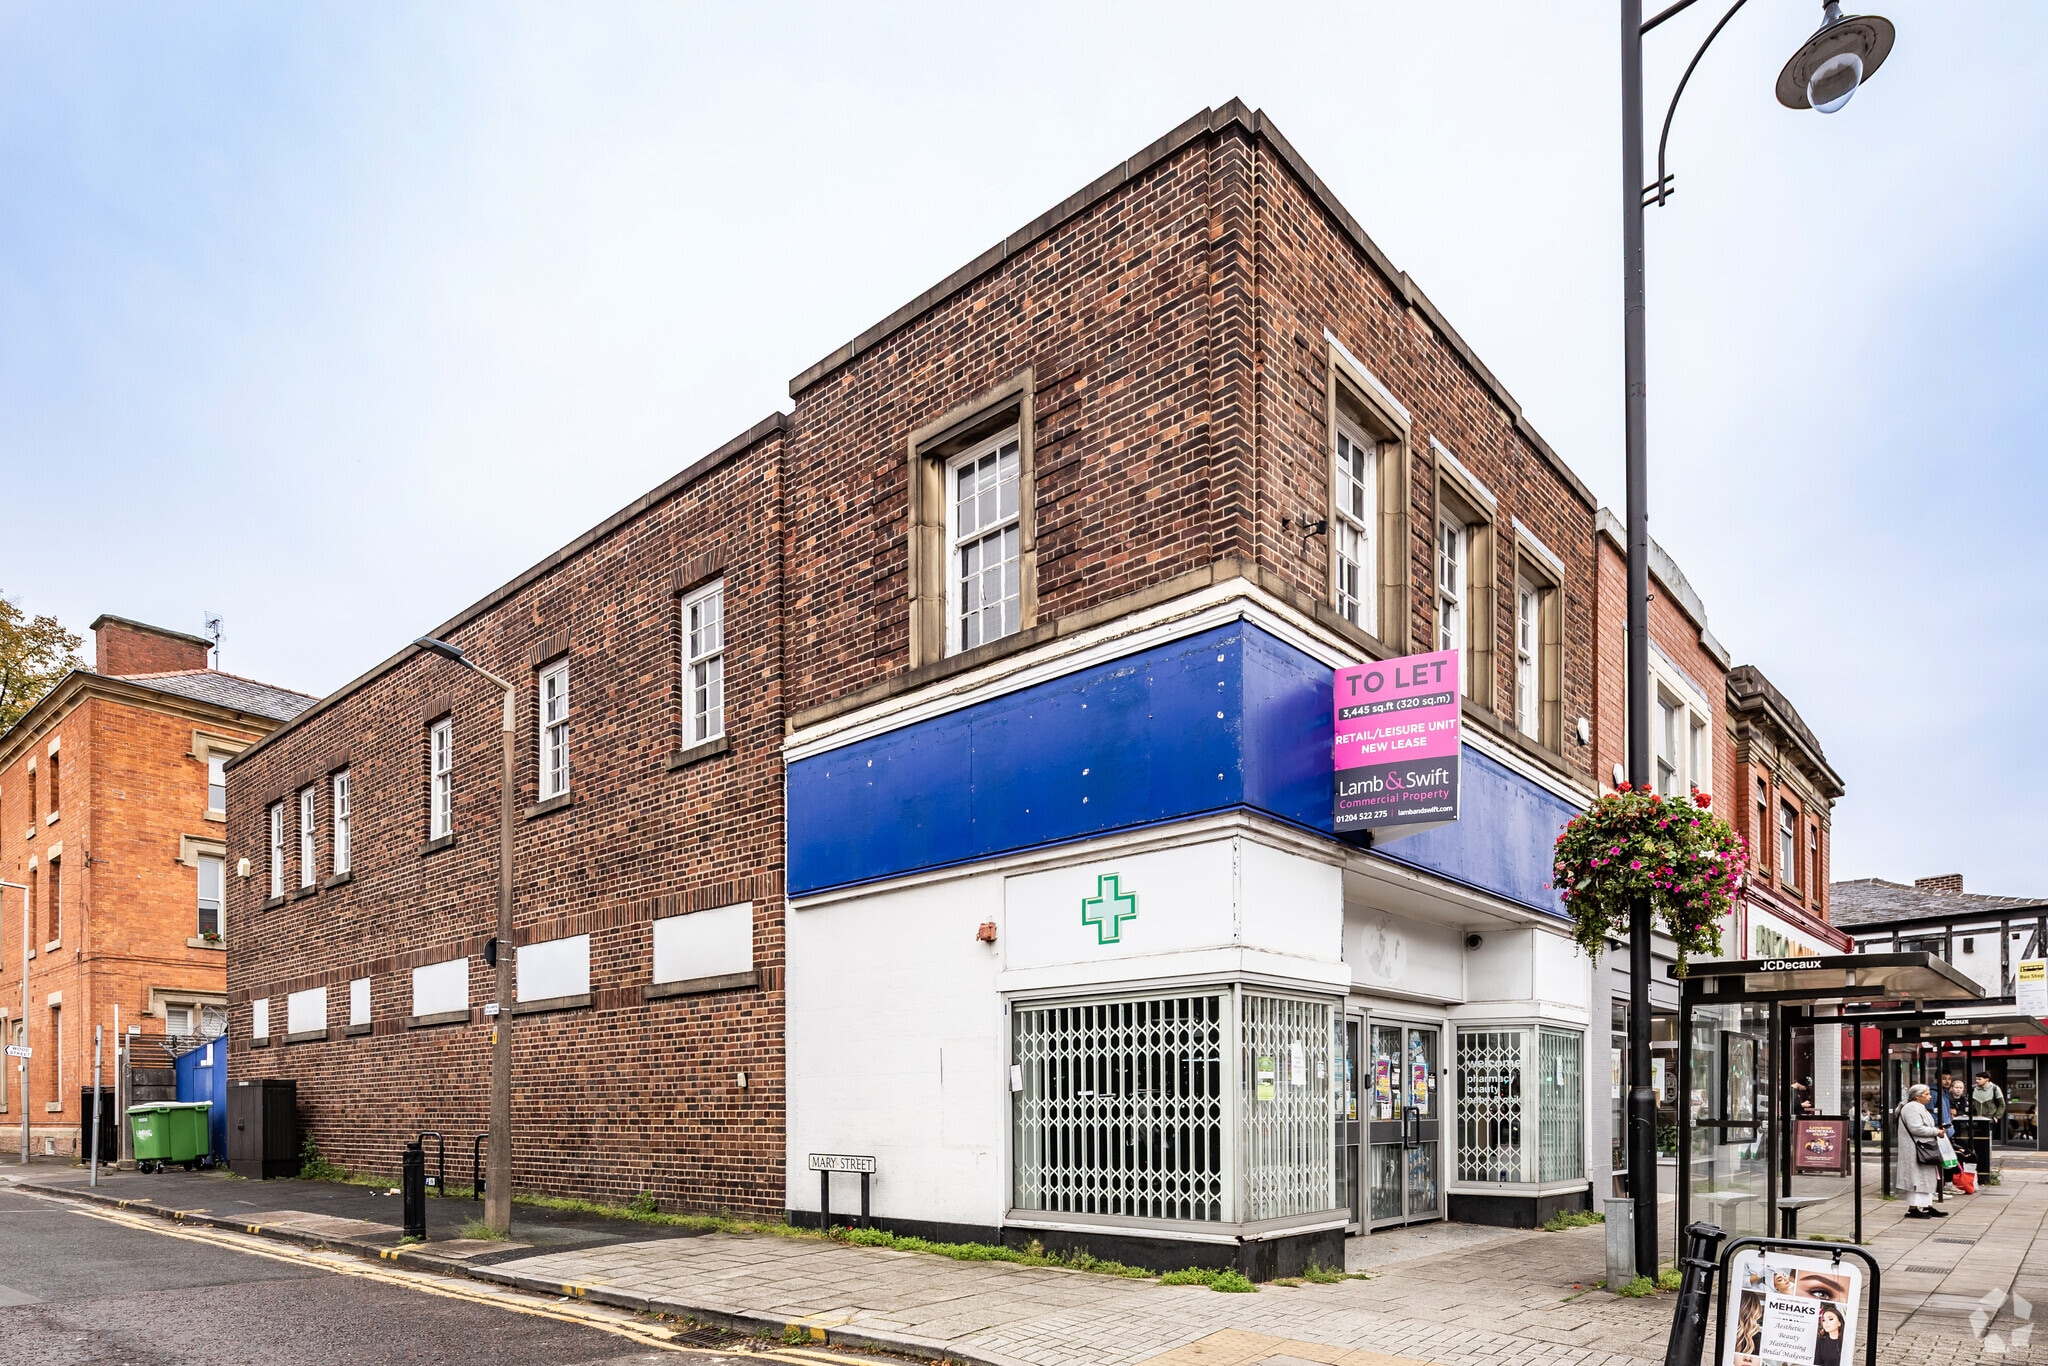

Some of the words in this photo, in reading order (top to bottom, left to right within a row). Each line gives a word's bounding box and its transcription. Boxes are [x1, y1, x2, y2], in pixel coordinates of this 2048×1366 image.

[1346, 671, 1384, 696] TO
[1395, 660, 1448, 689] LET
[1343, 705, 1370, 719] 3,445
[1372, 701, 1394, 714] sq.ft
[1396, 697, 1420, 710] (320
[1422, 693, 1451, 706] sq.m)
[1336, 723, 1426, 745] RETAIL/LEISURE
[1428, 719, 1457, 732] UNIT
[1361, 741, 1388, 754] NEW
[1391, 736, 1428, 750] LEASE
[1340, 775, 1384, 796] Lamb
[1385, 771, 1406, 790] &
[1406, 768, 1450, 788] Swift
[1339, 793, 1399, 809] Commercial
[1402, 789, 1450, 803] Property
[1336, 814, 1358, 823] 01204
[1359, 812, 1373, 821] 522
[1374, 810, 1388, 819] 275
[1397, 805, 1453, 816] lambandswift.com
[1760, 960, 1822, 971] JCDecaux
[1467, 1074, 1515, 1085] pharmacy
[1467, 1085, 1499, 1095] beauty
[812, 1156, 837, 1168] MARY
[840, 1158, 872, 1170] STREET
[1769, 1301, 1816, 1315] MEHAKS
[1774, 1323, 1805, 1332] Aesthetics
[1778, 1332, 1800, 1342] Beauty
[1762, 1348, 1782, 1356] Bridal
[1769, 1340, 1807, 1352] Hairdressing
